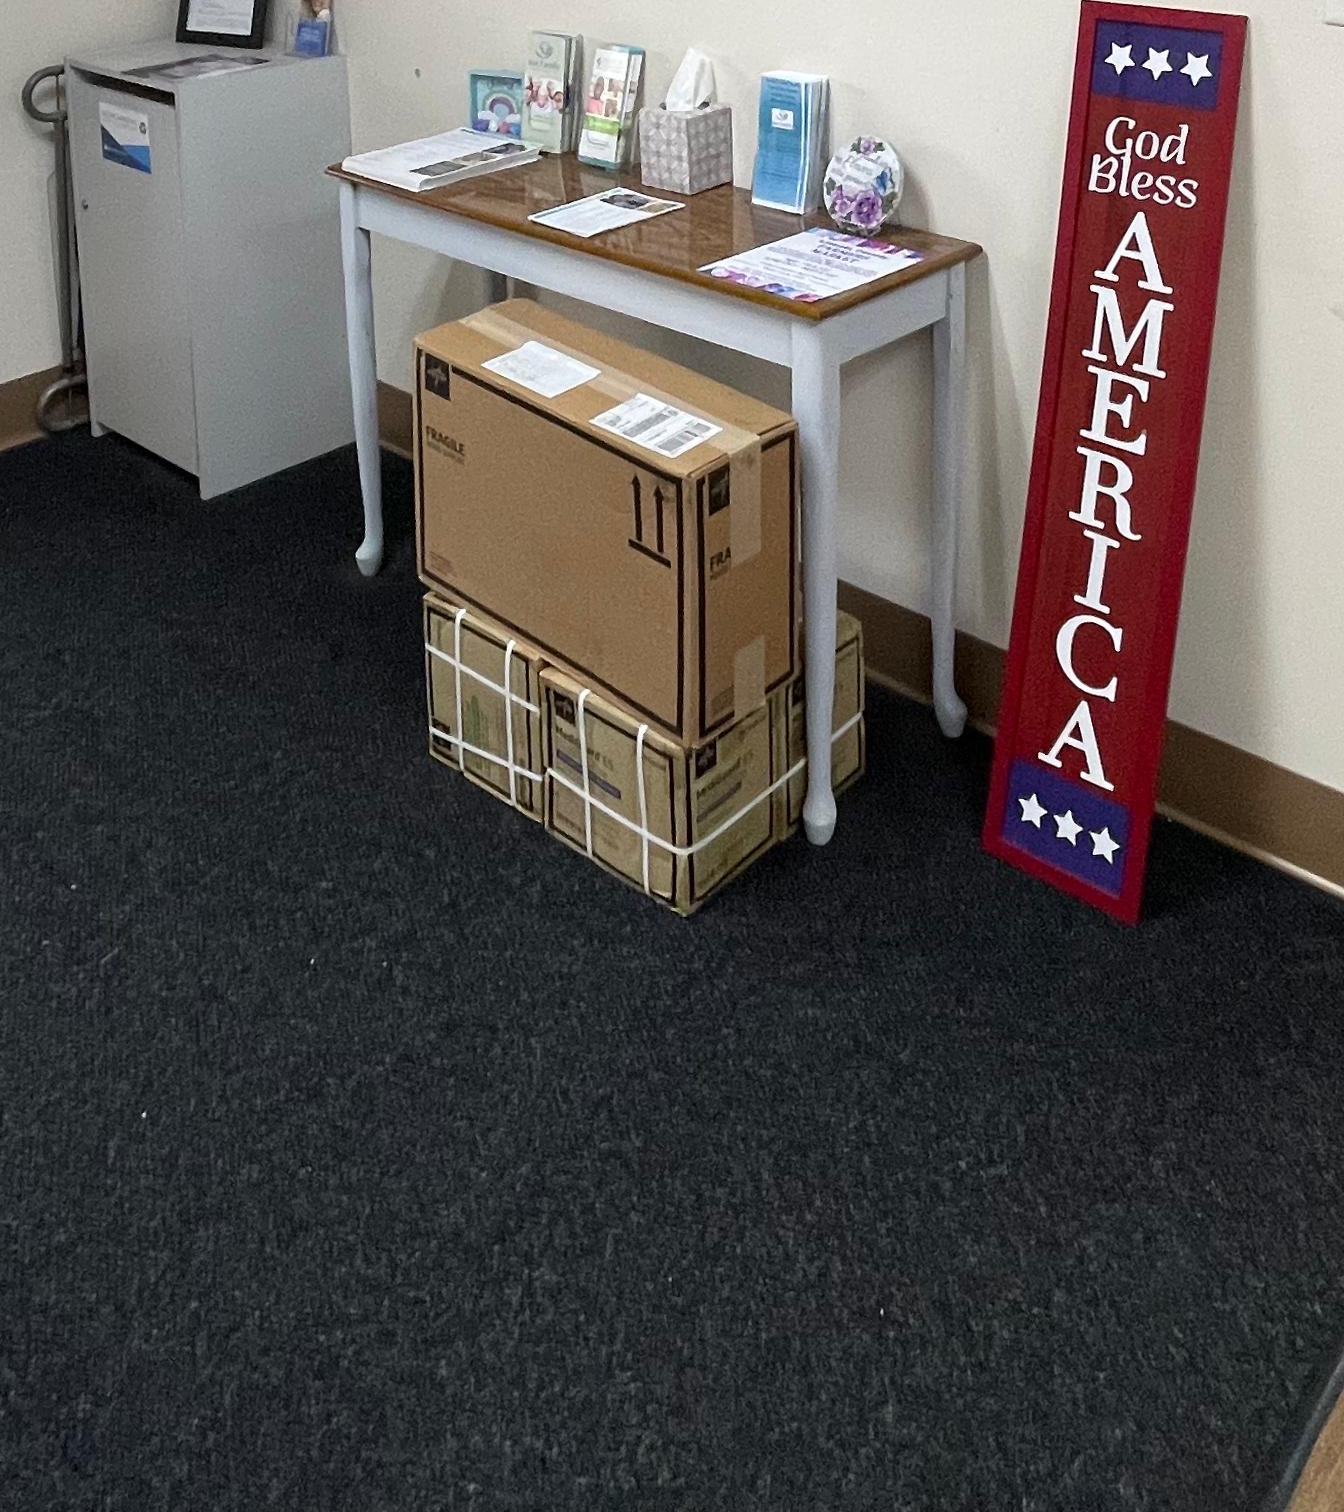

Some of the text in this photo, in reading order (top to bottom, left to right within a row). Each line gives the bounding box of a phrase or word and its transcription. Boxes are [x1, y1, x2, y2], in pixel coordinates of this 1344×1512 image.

[1105, 116, 1189, 165] God
[1088, 154, 1199, 209] Bless
[1038, 211, 1174, 792] AMERICA
